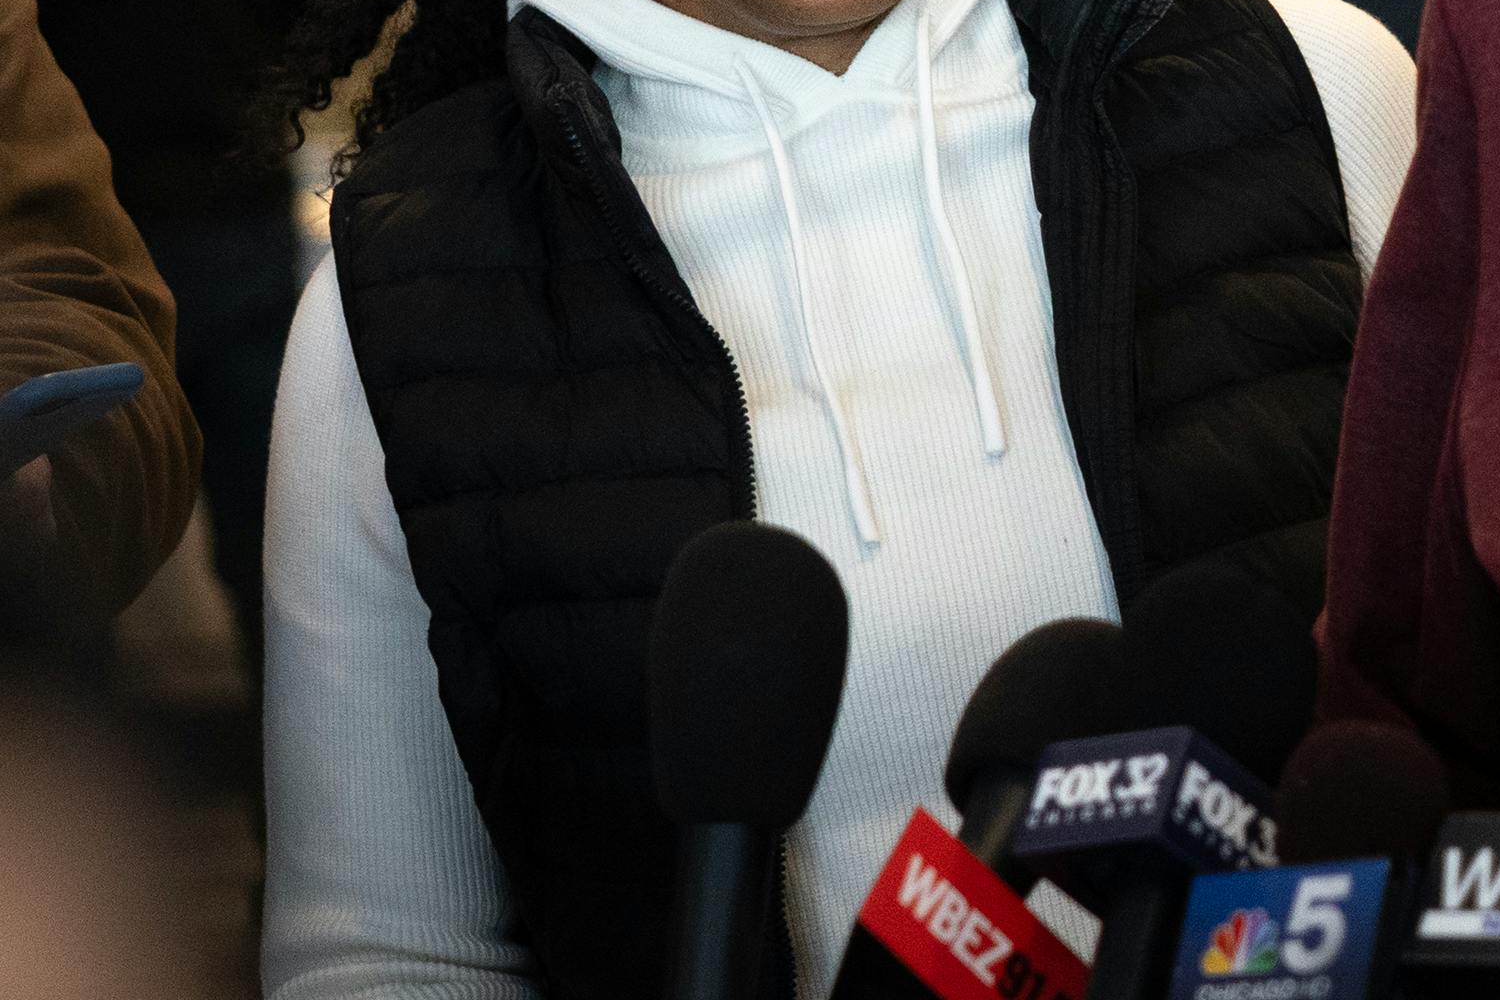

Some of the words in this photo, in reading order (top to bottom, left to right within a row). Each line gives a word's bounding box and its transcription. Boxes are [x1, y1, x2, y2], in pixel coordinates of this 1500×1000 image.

[1030, 758, 1122, 811] FOX
[1176, 759, 1257, 850] FOX
[897, 853, 1014, 988] WBEZ
[1279, 873, 1354, 975] 5
